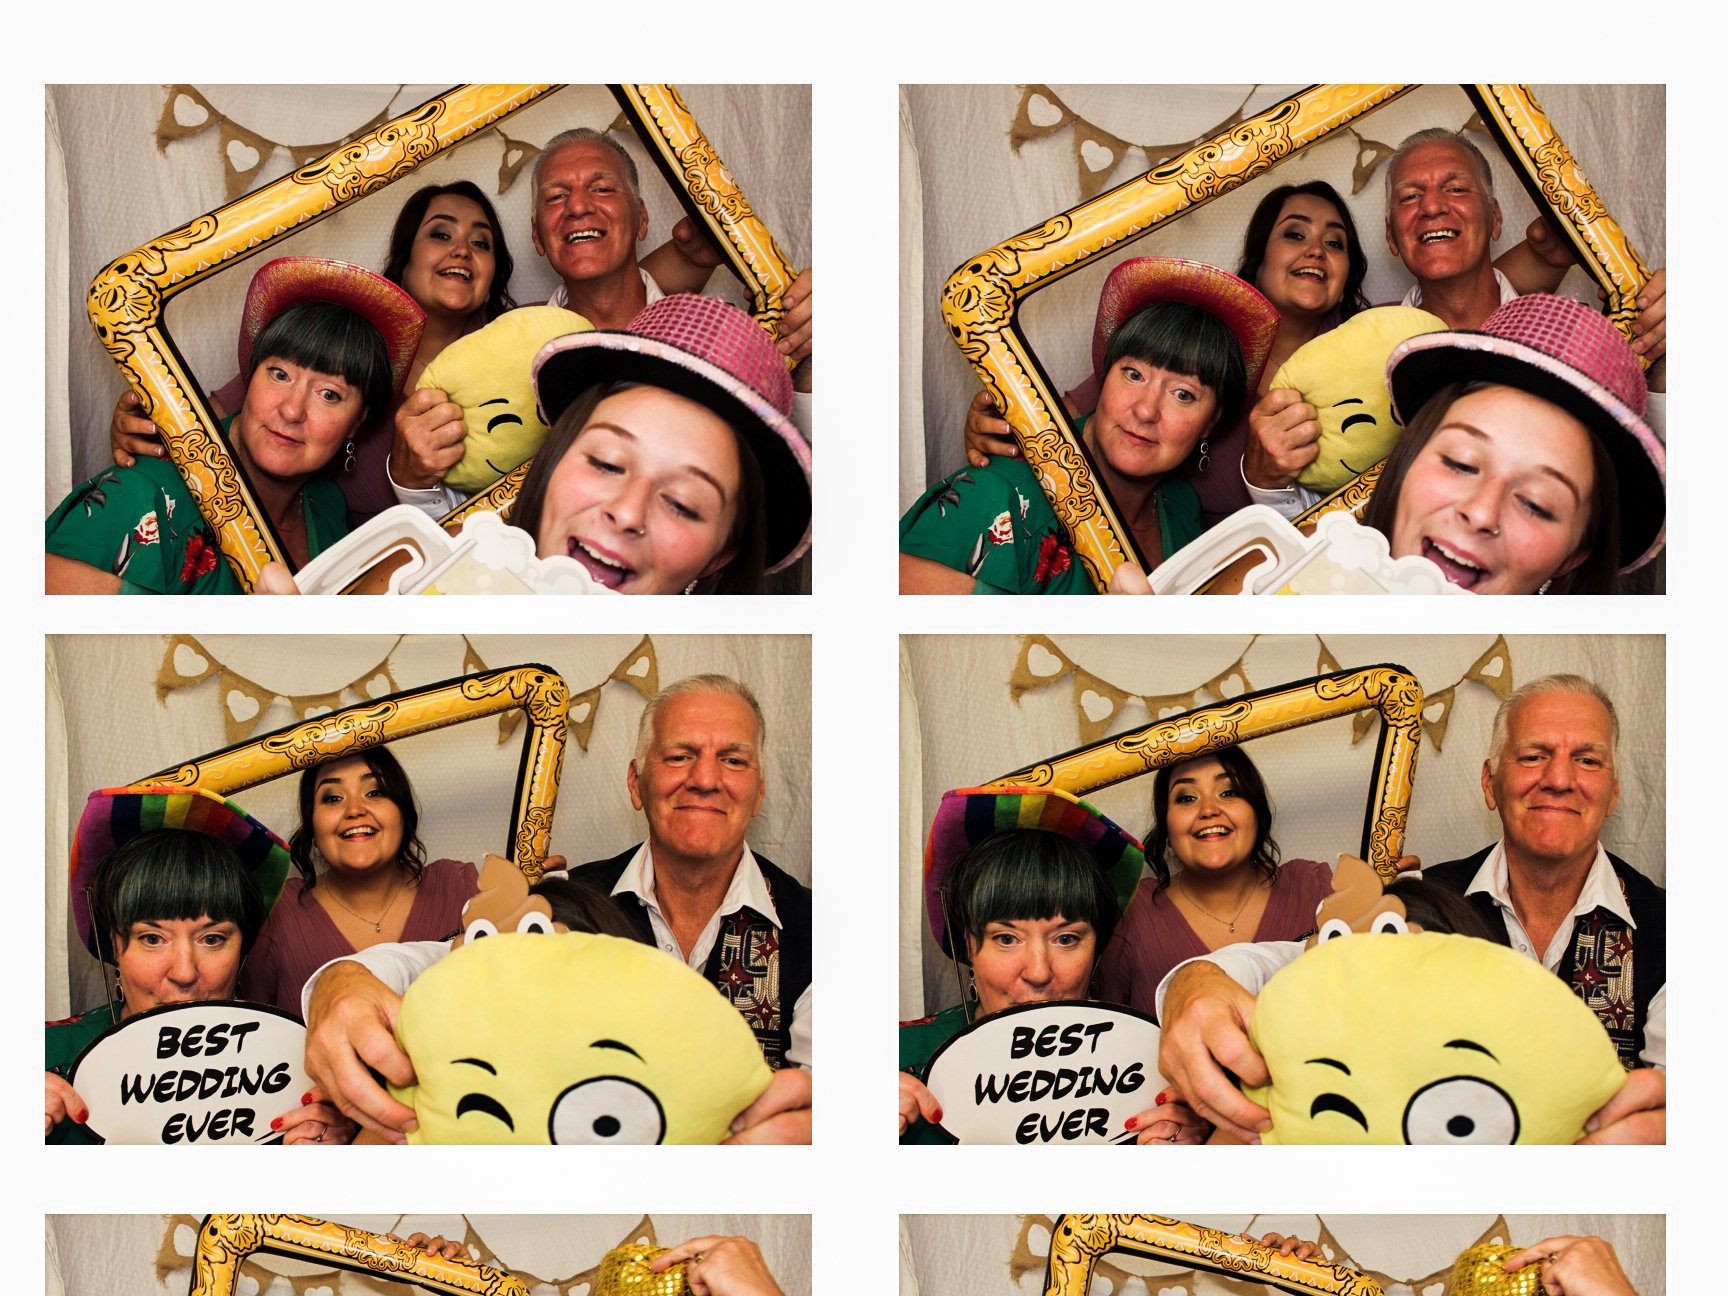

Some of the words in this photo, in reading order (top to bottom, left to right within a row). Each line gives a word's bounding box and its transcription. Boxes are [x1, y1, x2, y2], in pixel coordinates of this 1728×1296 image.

[156, 1021, 261, 1060] BEST
[1010, 1021, 1115, 1060] BEST
[120, 1061, 292, 1106] WEDDING
[974, 1061, 1146, 1106] WEDDING
[161, 1107, 256, 1145] EVER
[1015, 1107, 1110, 1145] EVER
